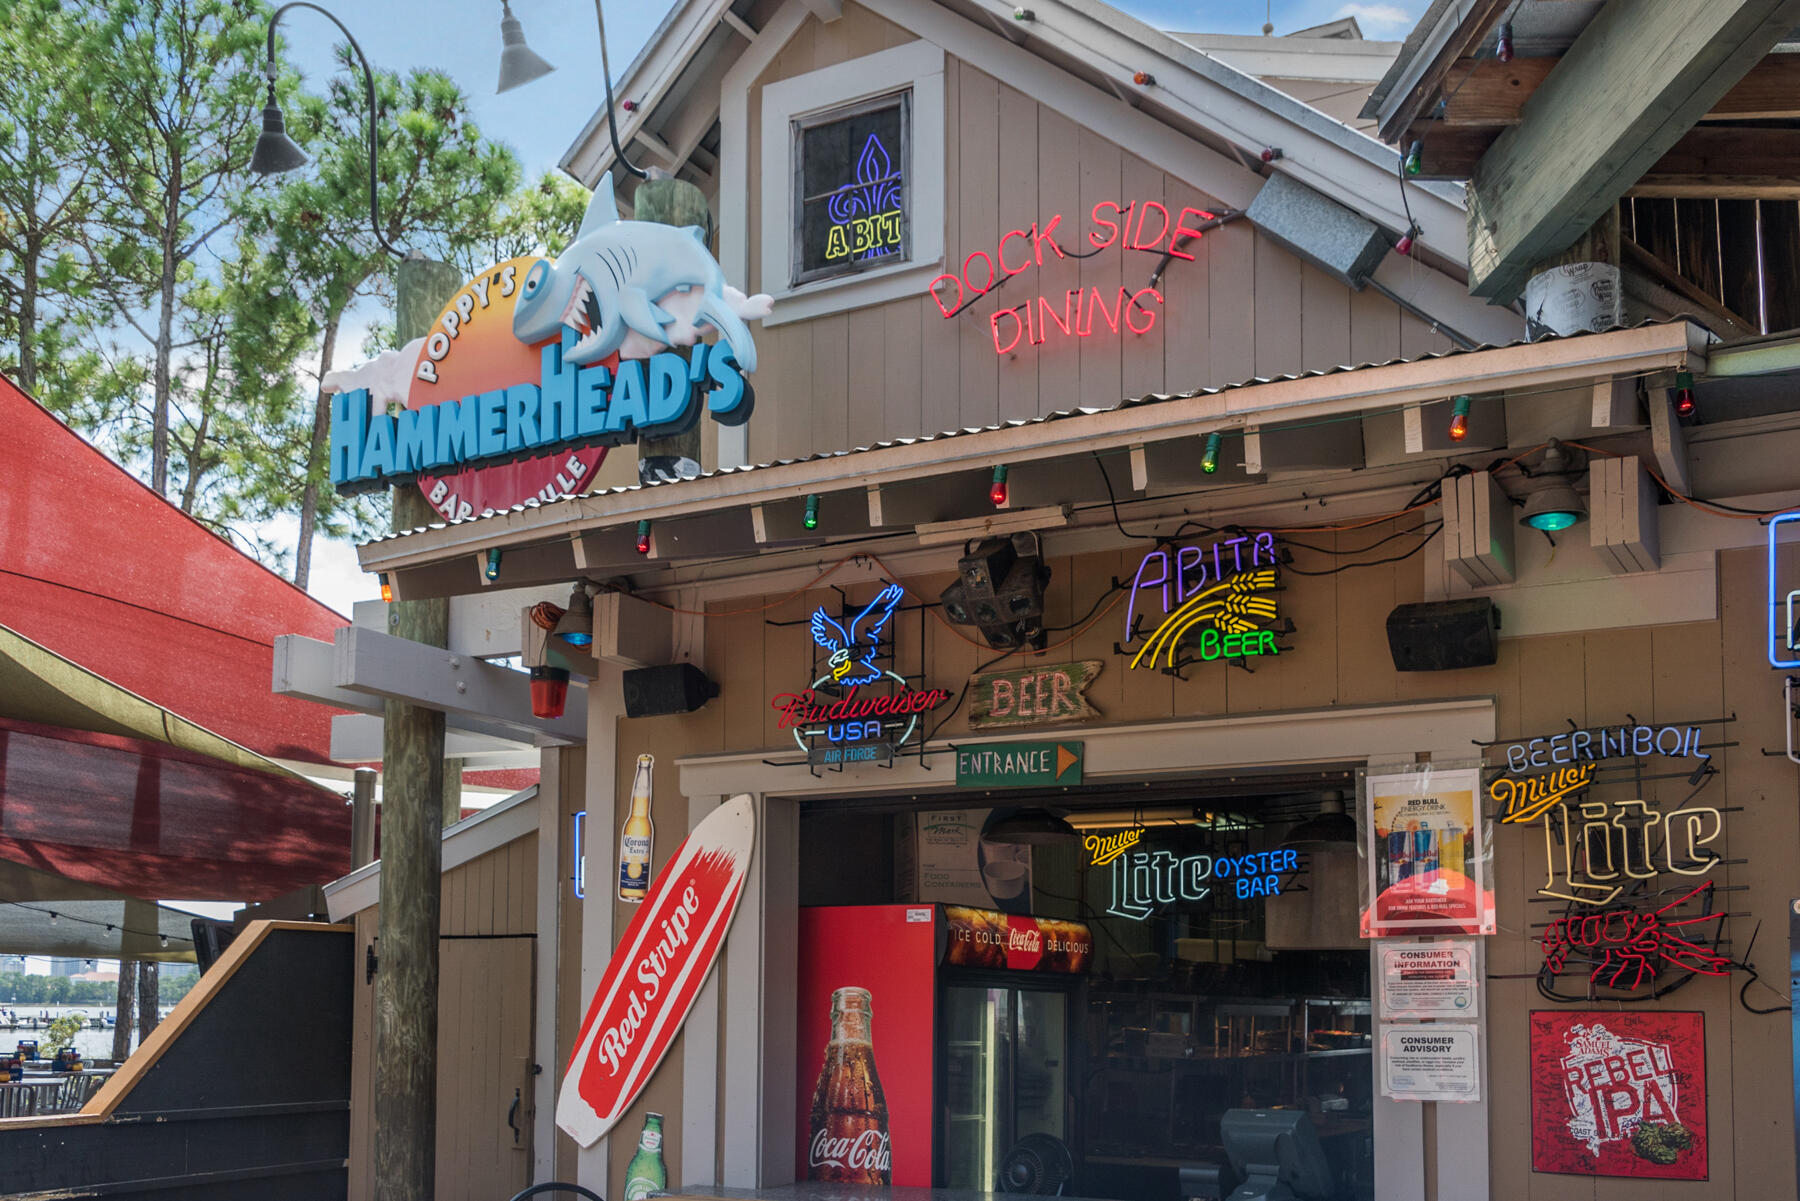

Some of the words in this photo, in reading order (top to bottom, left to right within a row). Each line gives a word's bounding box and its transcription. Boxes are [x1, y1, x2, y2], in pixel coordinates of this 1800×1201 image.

[929, 214, 1066, 319] DOCK
[1088, 200, 1216, 262] SIDE
[417, 265, 517, 384] POPPY'S
[990, 285, 1164, 354] DINING
[428, 479, 474, 521] BAR
[1126, 532, 1276, 643] ABITA
[1200, 628, 1279, 661] BEER
[771, 684, 951, 730] Budweiser
[988, 670, 1076, 718] BEER
[827, 720, 882, 742] USA
[1505, 730, 1594, 773] BEER
[1601, 727, 1625, 758] N
[1631, 726, 1711, 759] BOIL
[824, 749, 843, 763] AIR
[844, 746, 878, 762] FORCE
[959, 749, 1051, 775] ENTRANCE
[1490, 762, 1598, 819] Miller
[624, 836, 649, 848] Corona
[1084, 828, 1146, 865] Miller
[1537, 799, 1721, 906] Lite
[1213, 848, 1299, 879] OYSTER
[1106, 850, 1213, 920] Lite
[1235, 874, 1281, 900] BAR
[954, 929, 970, 942] ICE
[975, 931, 1001, 945] COLD
[1047, 939, 1089, 954] DELICIOUS
[1400, 951, 1454, 959] CONSUMER
[598, 994, 649, 1078] Red
[637, 888, 700, 1003] Stripe
[1394, 960, 1461, 969] INFORMATION
[1403, 1045, 1452, 1053] ADVISORY
[1575, 1038, 1613, 1050] SAMUEL
[1578, 1047, 1610, 1057] ADAMS
[1563, 1045, 1674, 1099] REBEL
[1588, 1080, 1678, 1141] IPA
[809, 1127, 892, 1171] Coca-Cola
